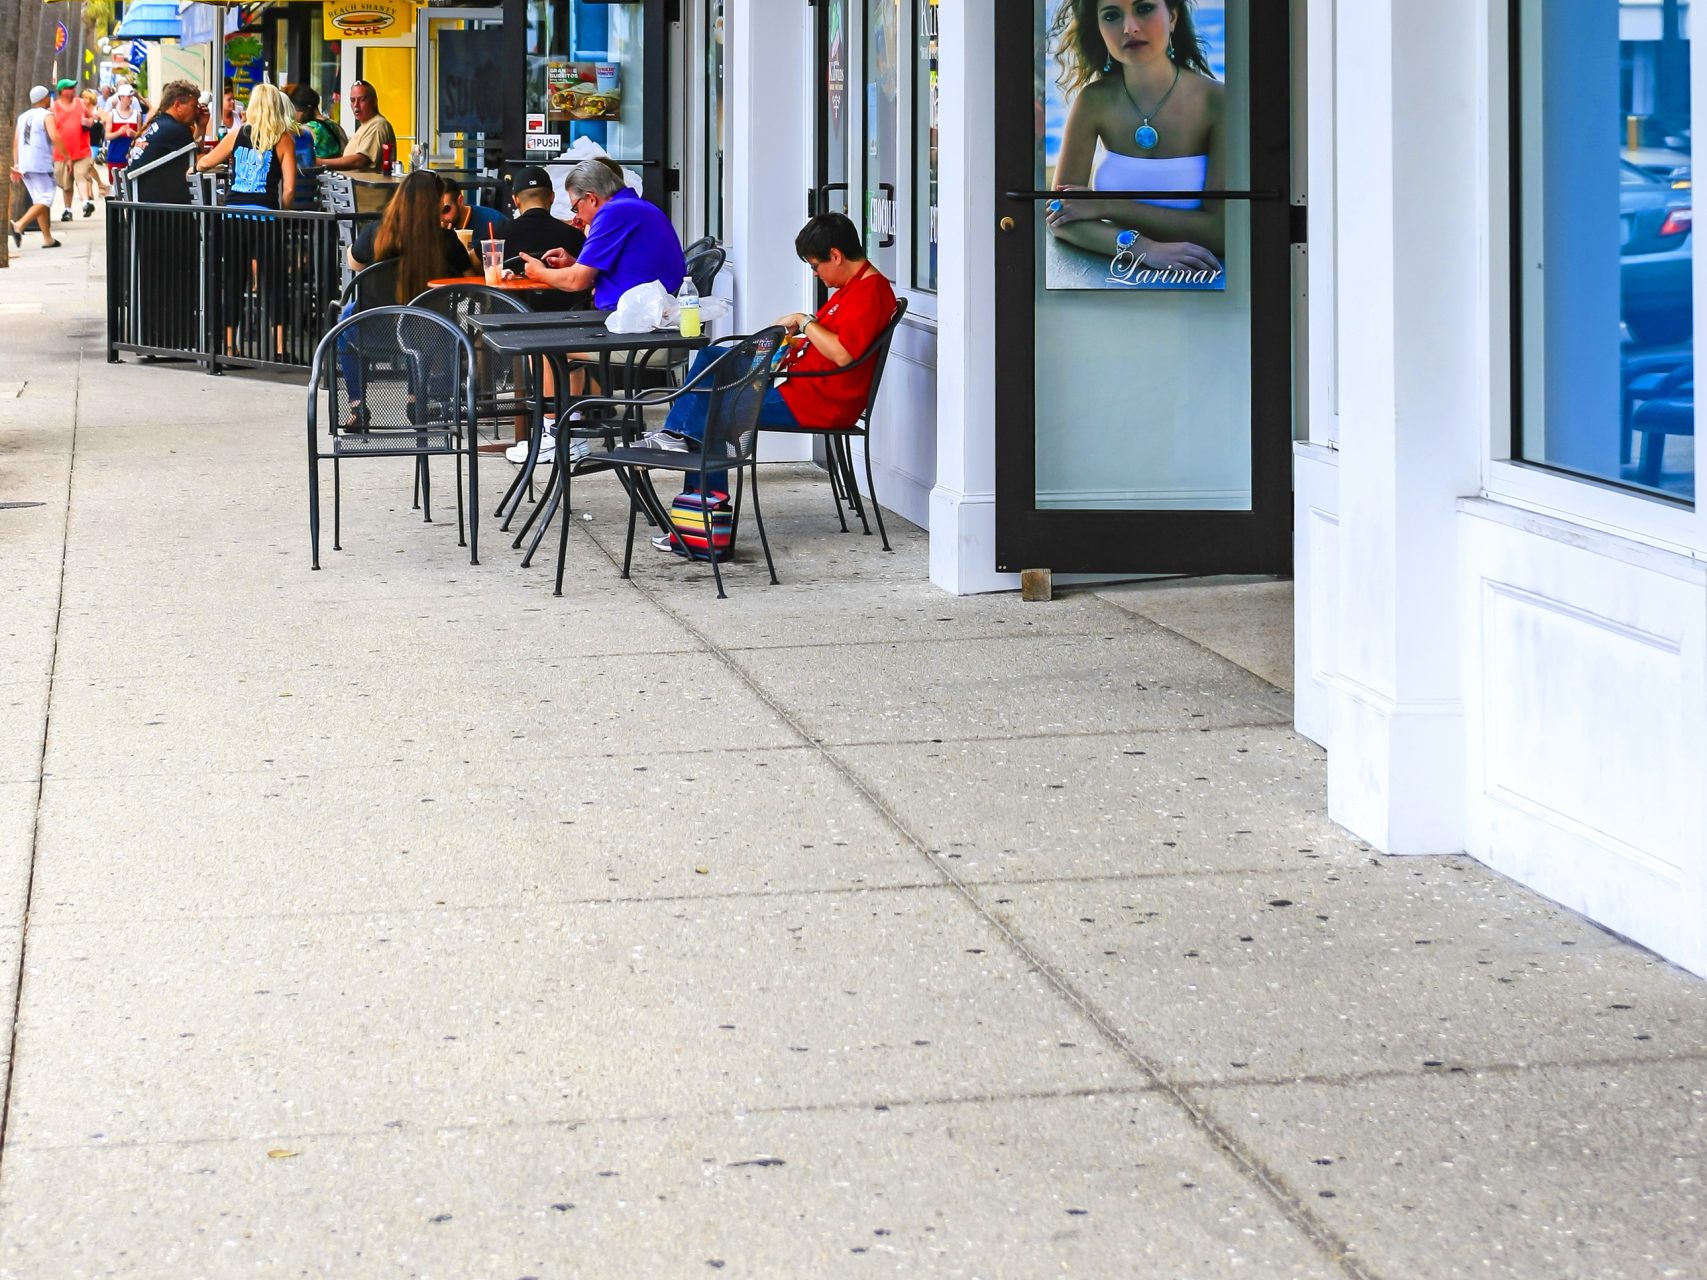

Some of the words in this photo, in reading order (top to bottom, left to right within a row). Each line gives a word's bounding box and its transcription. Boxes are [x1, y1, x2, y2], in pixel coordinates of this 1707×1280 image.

[328, 4, 358, 19] BEACH
[360, 3, 398, 16] SHANTY
[536, 138, 560, 147] PUSH
[1105, 250, 1222, 286] Larimar
